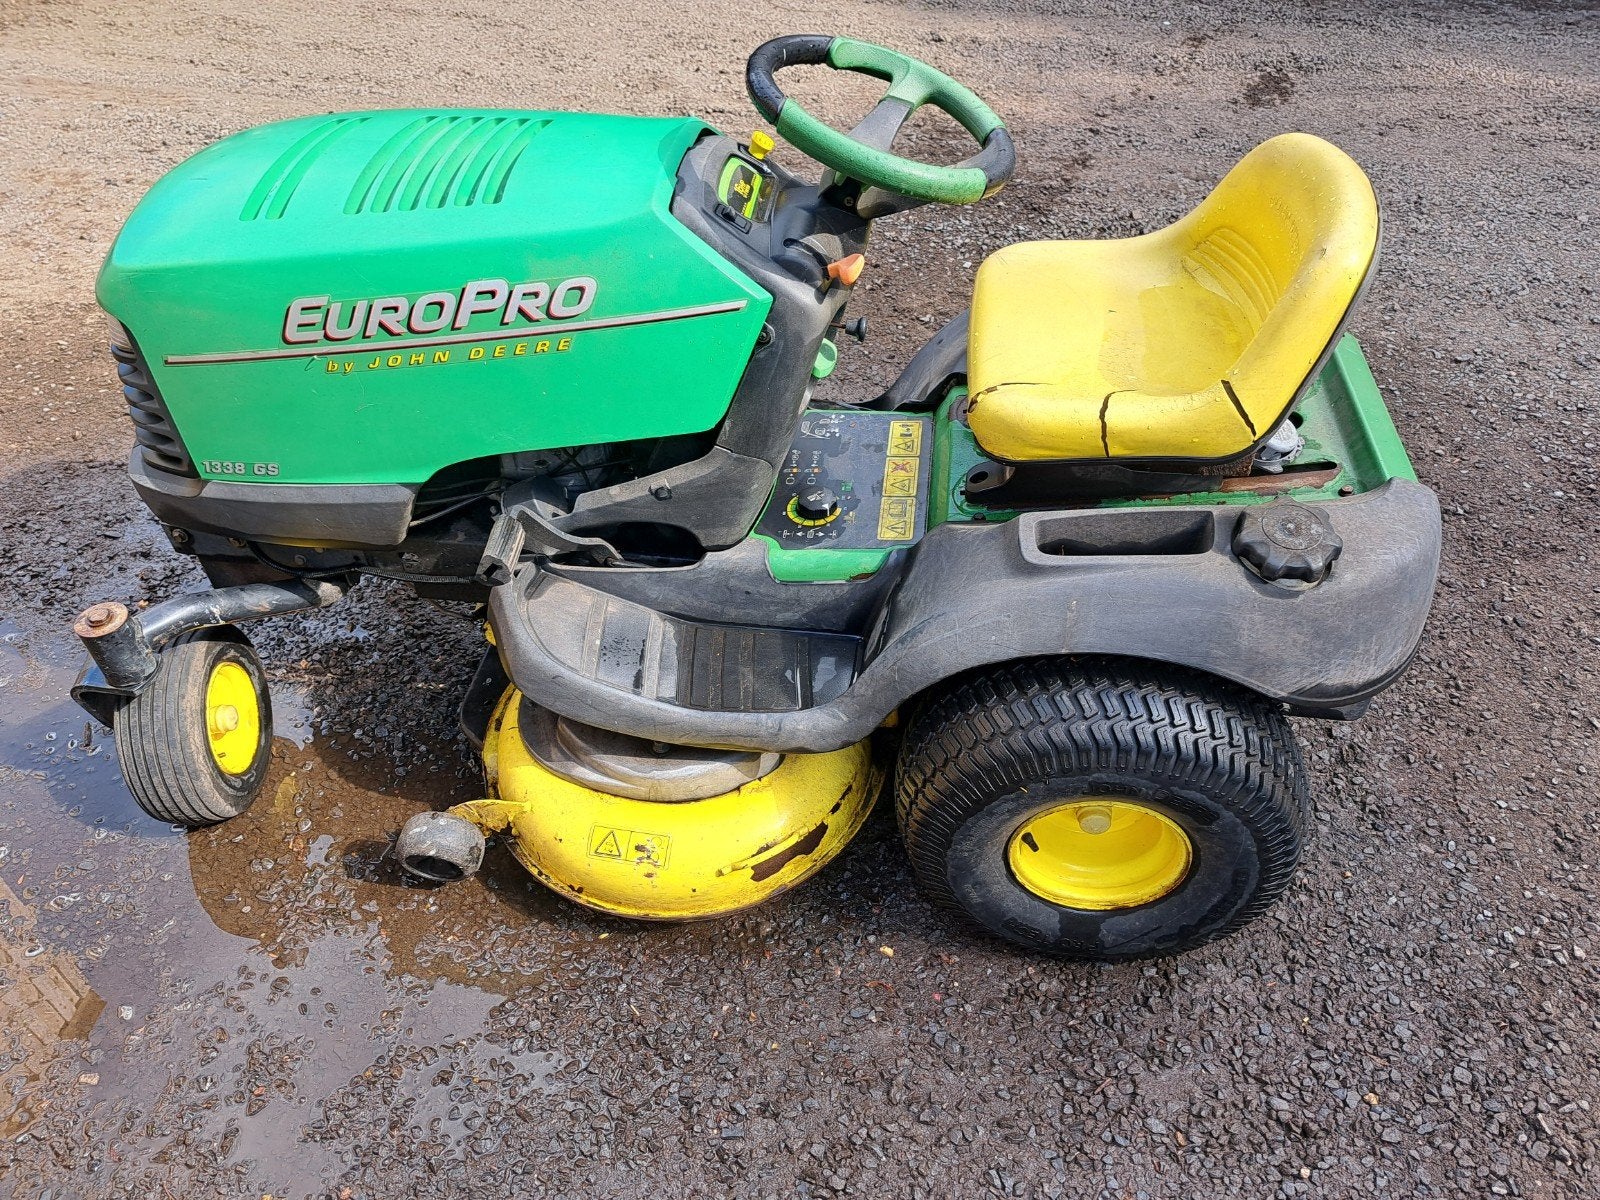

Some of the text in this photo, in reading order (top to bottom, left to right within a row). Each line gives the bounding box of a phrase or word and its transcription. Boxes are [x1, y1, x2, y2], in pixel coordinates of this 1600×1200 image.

[326, 338, 571, 375] by JOHN DEERE
[202, 461, 280, 476] 1338 GS
